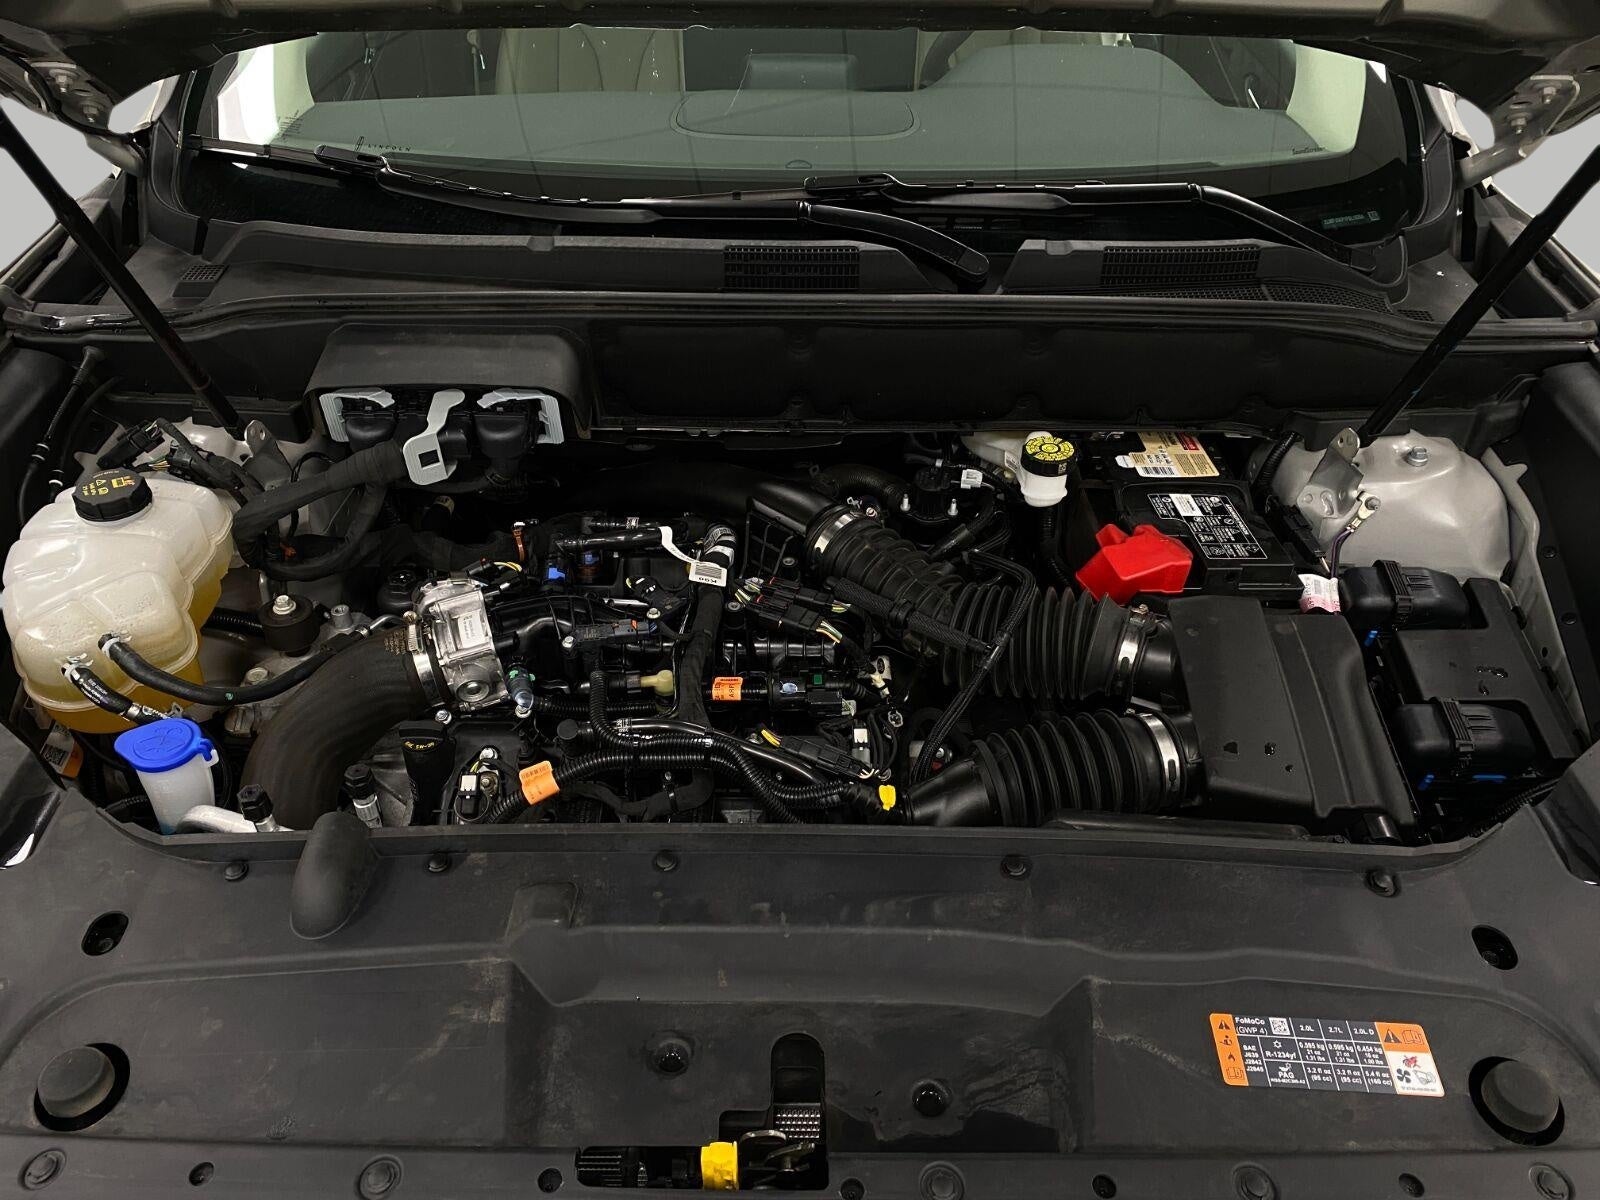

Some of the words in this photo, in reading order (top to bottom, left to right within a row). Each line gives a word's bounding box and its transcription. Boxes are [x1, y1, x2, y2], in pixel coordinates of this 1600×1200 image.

[367, 143, 411, 152] LINCOLN
[1235, 1017, 1266, 1025] FoMoCo
[1236, 1026, 1258, 1034] (GWP
[1259, 1027, 1268, 1036] 4)
[1328, 1026, 1344, 1034] 2.7L
[1278, 1071, 1295, 1079] PAG
